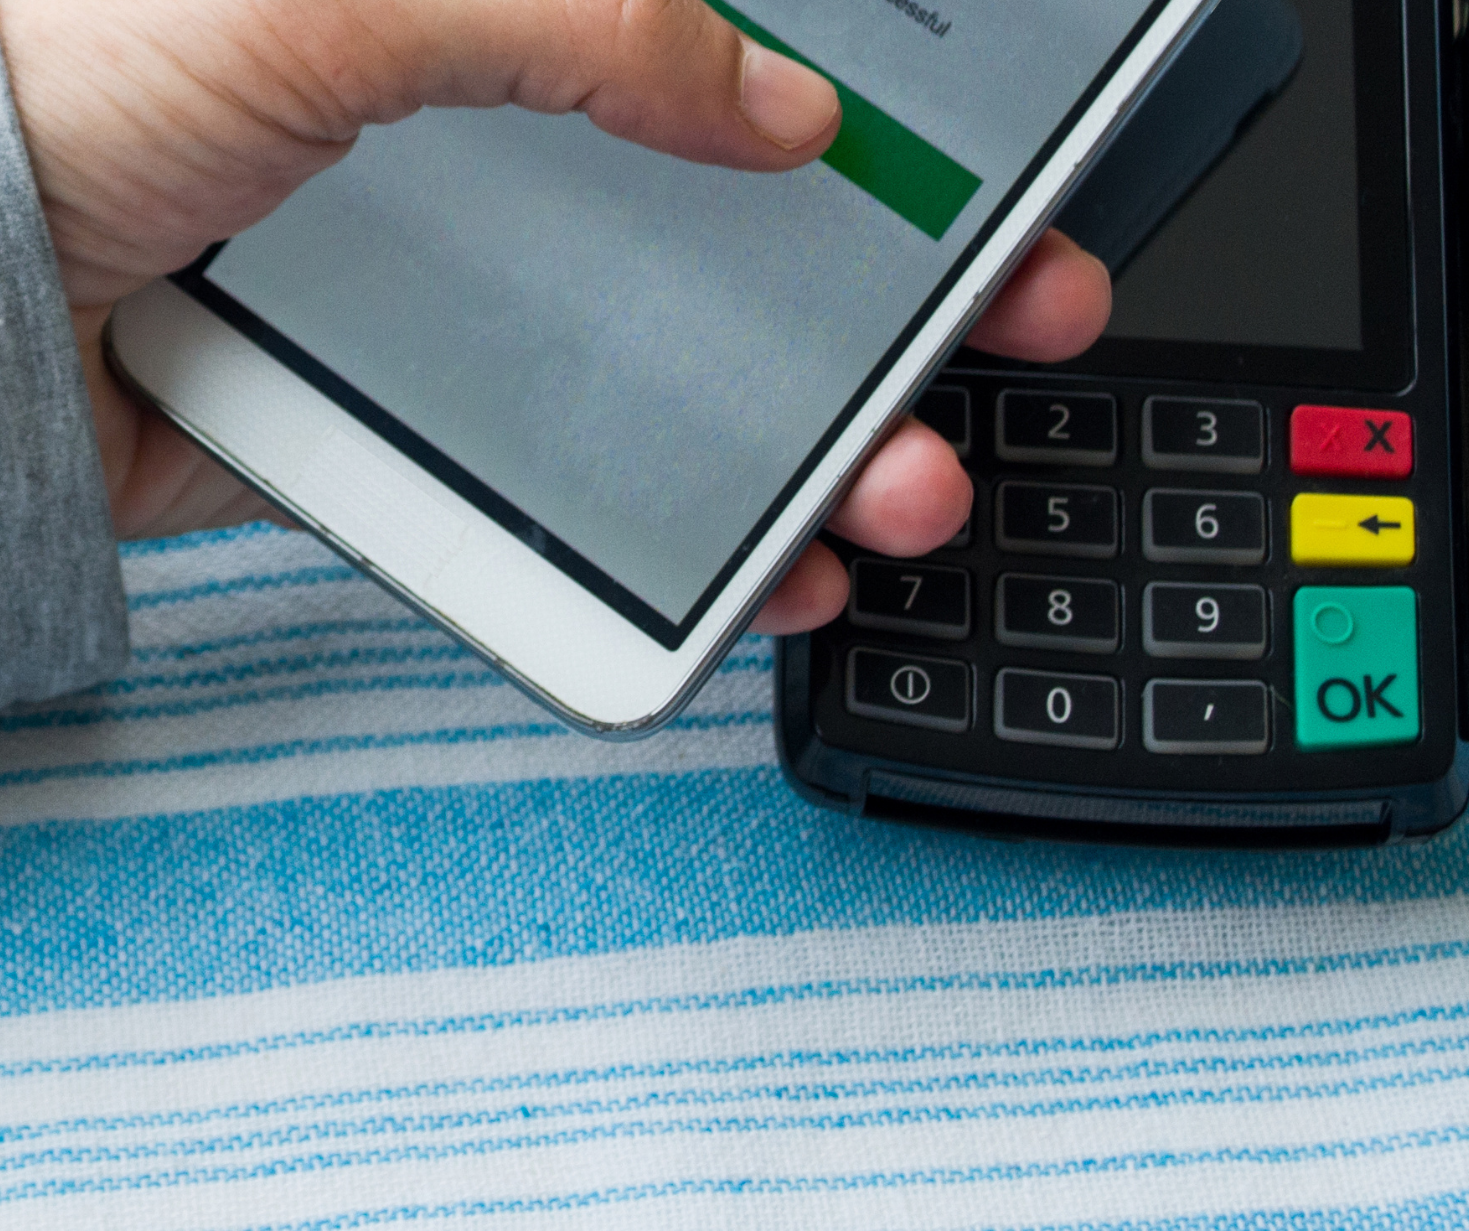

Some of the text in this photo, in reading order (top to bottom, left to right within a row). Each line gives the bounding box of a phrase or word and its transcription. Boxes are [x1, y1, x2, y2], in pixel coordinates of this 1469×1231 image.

[1047, 404, 1071, 440] 2
[1196, 410, 1219, 447] 3
[1363, 419, 1395, 454] X
[1047, 496, 1071, 533] 5
[1194, 503, 1220, 540] 6
[899, 575, 923, 611] 7
[1046, 589, 1073, 626] 8
[1195, 597, 1221, 634] 9
[1046, 686, 1073, 725] 0
[1316, 674, 1404, 723] OK
